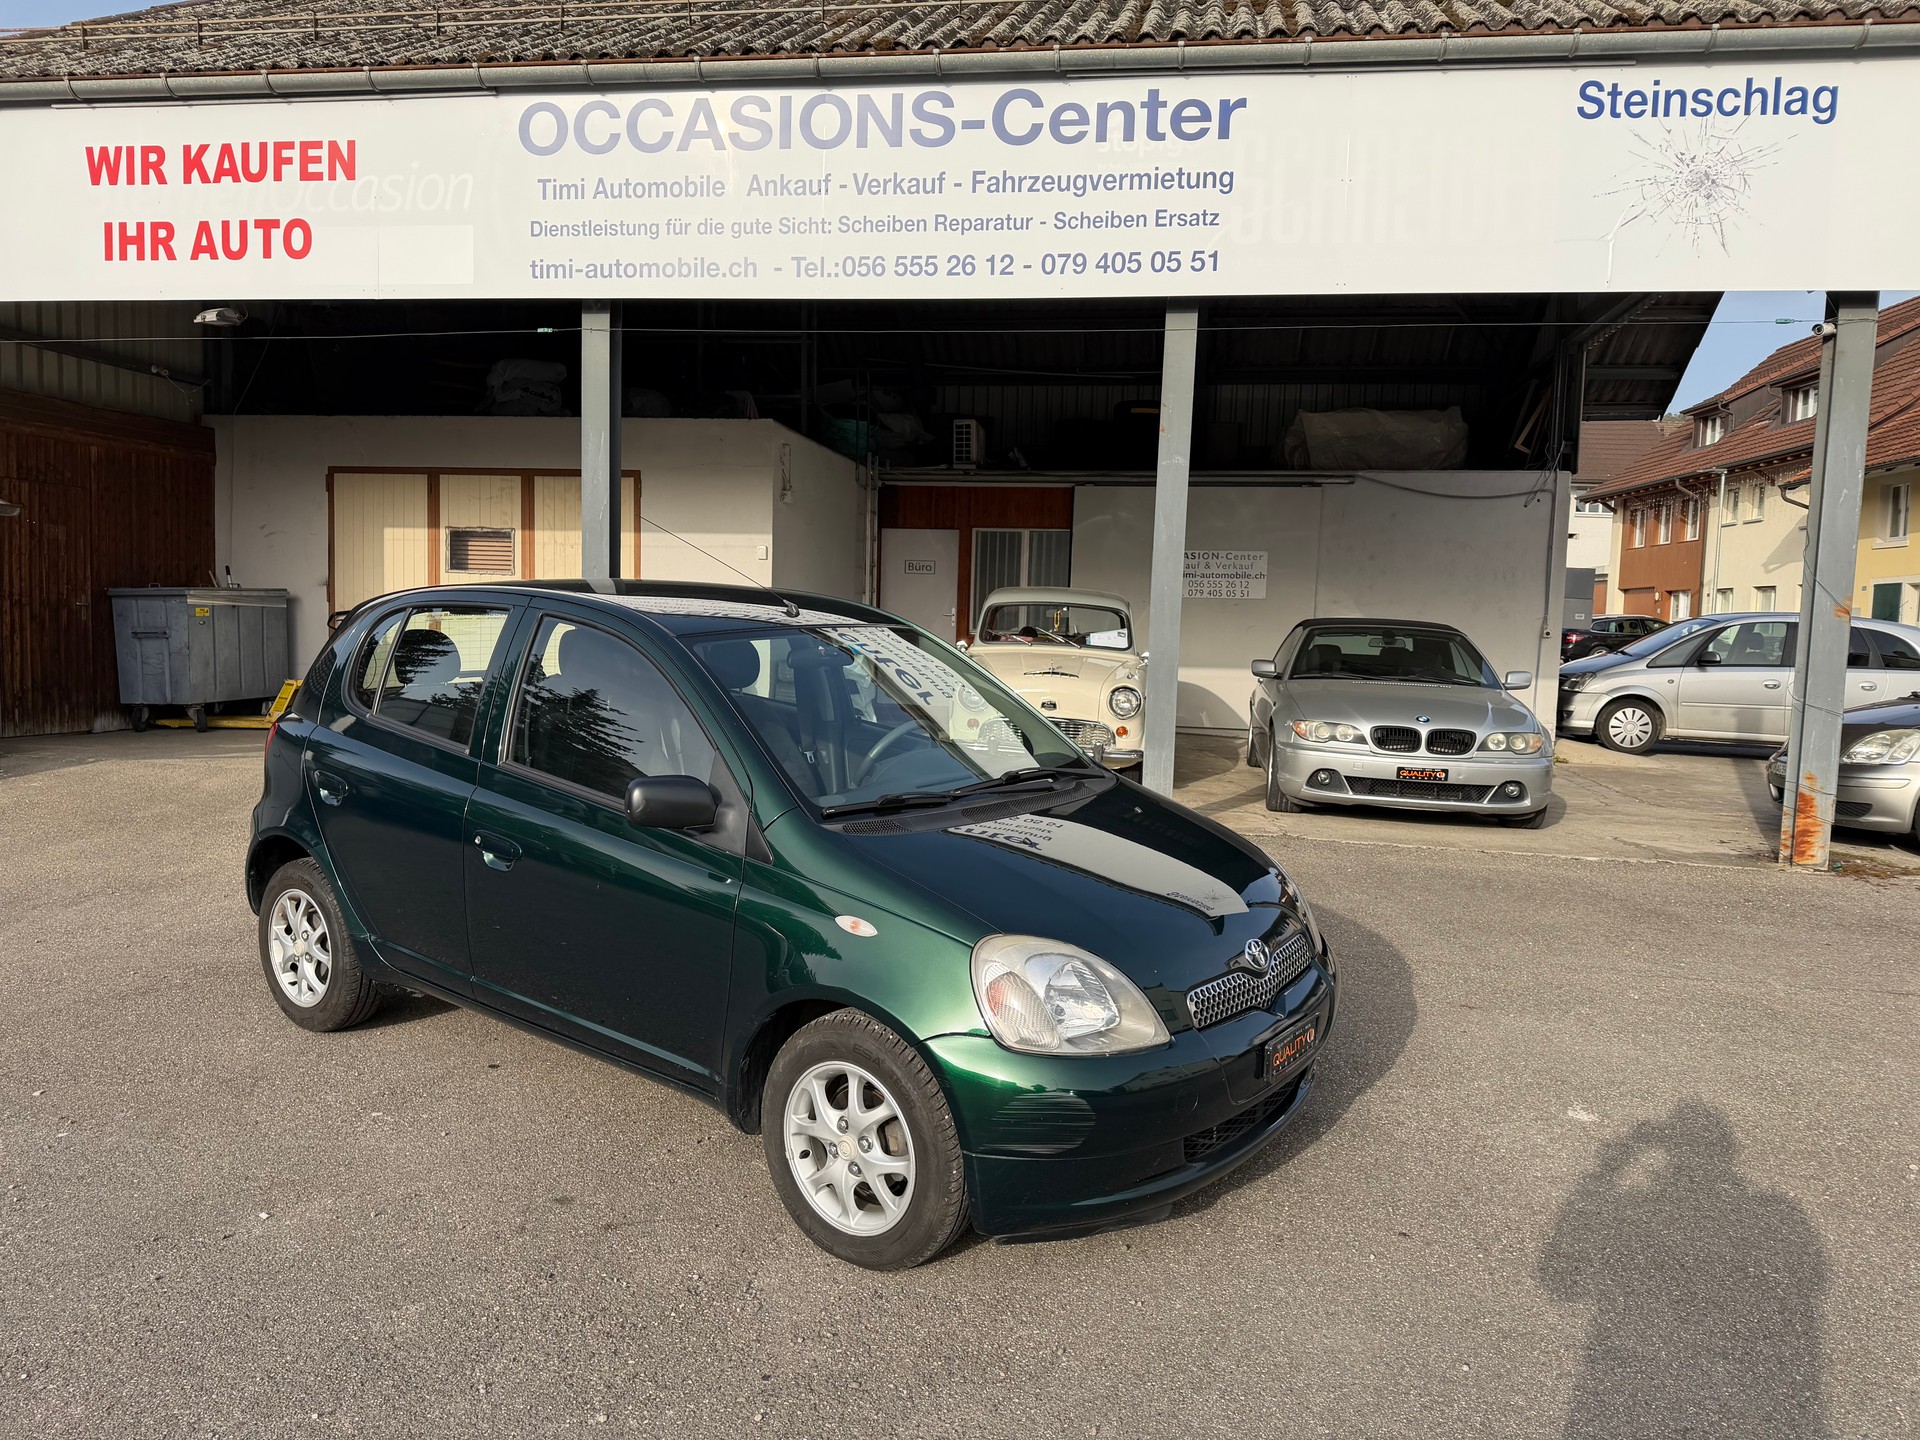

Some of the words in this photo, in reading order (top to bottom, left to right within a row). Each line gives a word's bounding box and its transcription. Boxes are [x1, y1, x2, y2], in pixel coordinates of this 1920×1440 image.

[1576, 76, 1840, 125] Steinschlag
[517, 88, 1248, 156] OCCASIONS-Center
[85, 145, 168, 187] WIR
[182, 139, 357, 185] KAUFEN
[537, 177, 586, 200] Timi
[592, 175, 726, 200] Automobile
[746, 173, 832, 197] Ankauf
[852, 171, 946, 196] Verkauf
[971, 166, 1235, 198] Fahrzeugvermietung
[103, 221, 177, 262] IHR
[189, 217, 314, 261] AUTO
[529, 219, 660, 240] Dienstleistung
[665, 218, 692, 236] für
[696, 218, 725, 236] die
[730, 217, 773, 239] gute
[778, 216, 833, 236] Sicht:
[837, 214, 928, 234] Scheiben
[934, 213, 1034, 236] Reparatur
[1053, 210, 1148, 230] Scheiben
[1154, 209, 1220, 228] Ersatz
[529, 256, 758, 280] timi-automobile.ch
[893, 255, 939, 277] 555
[946, 254, 976, 277] 26
[985, 253, 1015, 276] 12
[1041, 252, 1088, 275] 079
[1095, 251, 1142, 274] 405
[1150, 250, 1182, 273] 05
[1190, 249, 1219, 272] 51
[908, 562, 932, 571] Büro
[1183, 561, 1200, 569] auf
[1204, 561, 1211, 569] &
[1215, 561, 1254, 570] Verkauf
[1188, 580, 1204, 588] 056
[1206, 580, 1222, 589] 555
[1225, 580, 1236, 589] 26
[1240, 580, 1249, 589] 12
[1188, 589, 1204, 597] 079
[1206, 589, 1222, 597] 405
[1225, 589, 1236, 597] 05
[1240, 589, 1249, 597] 51
